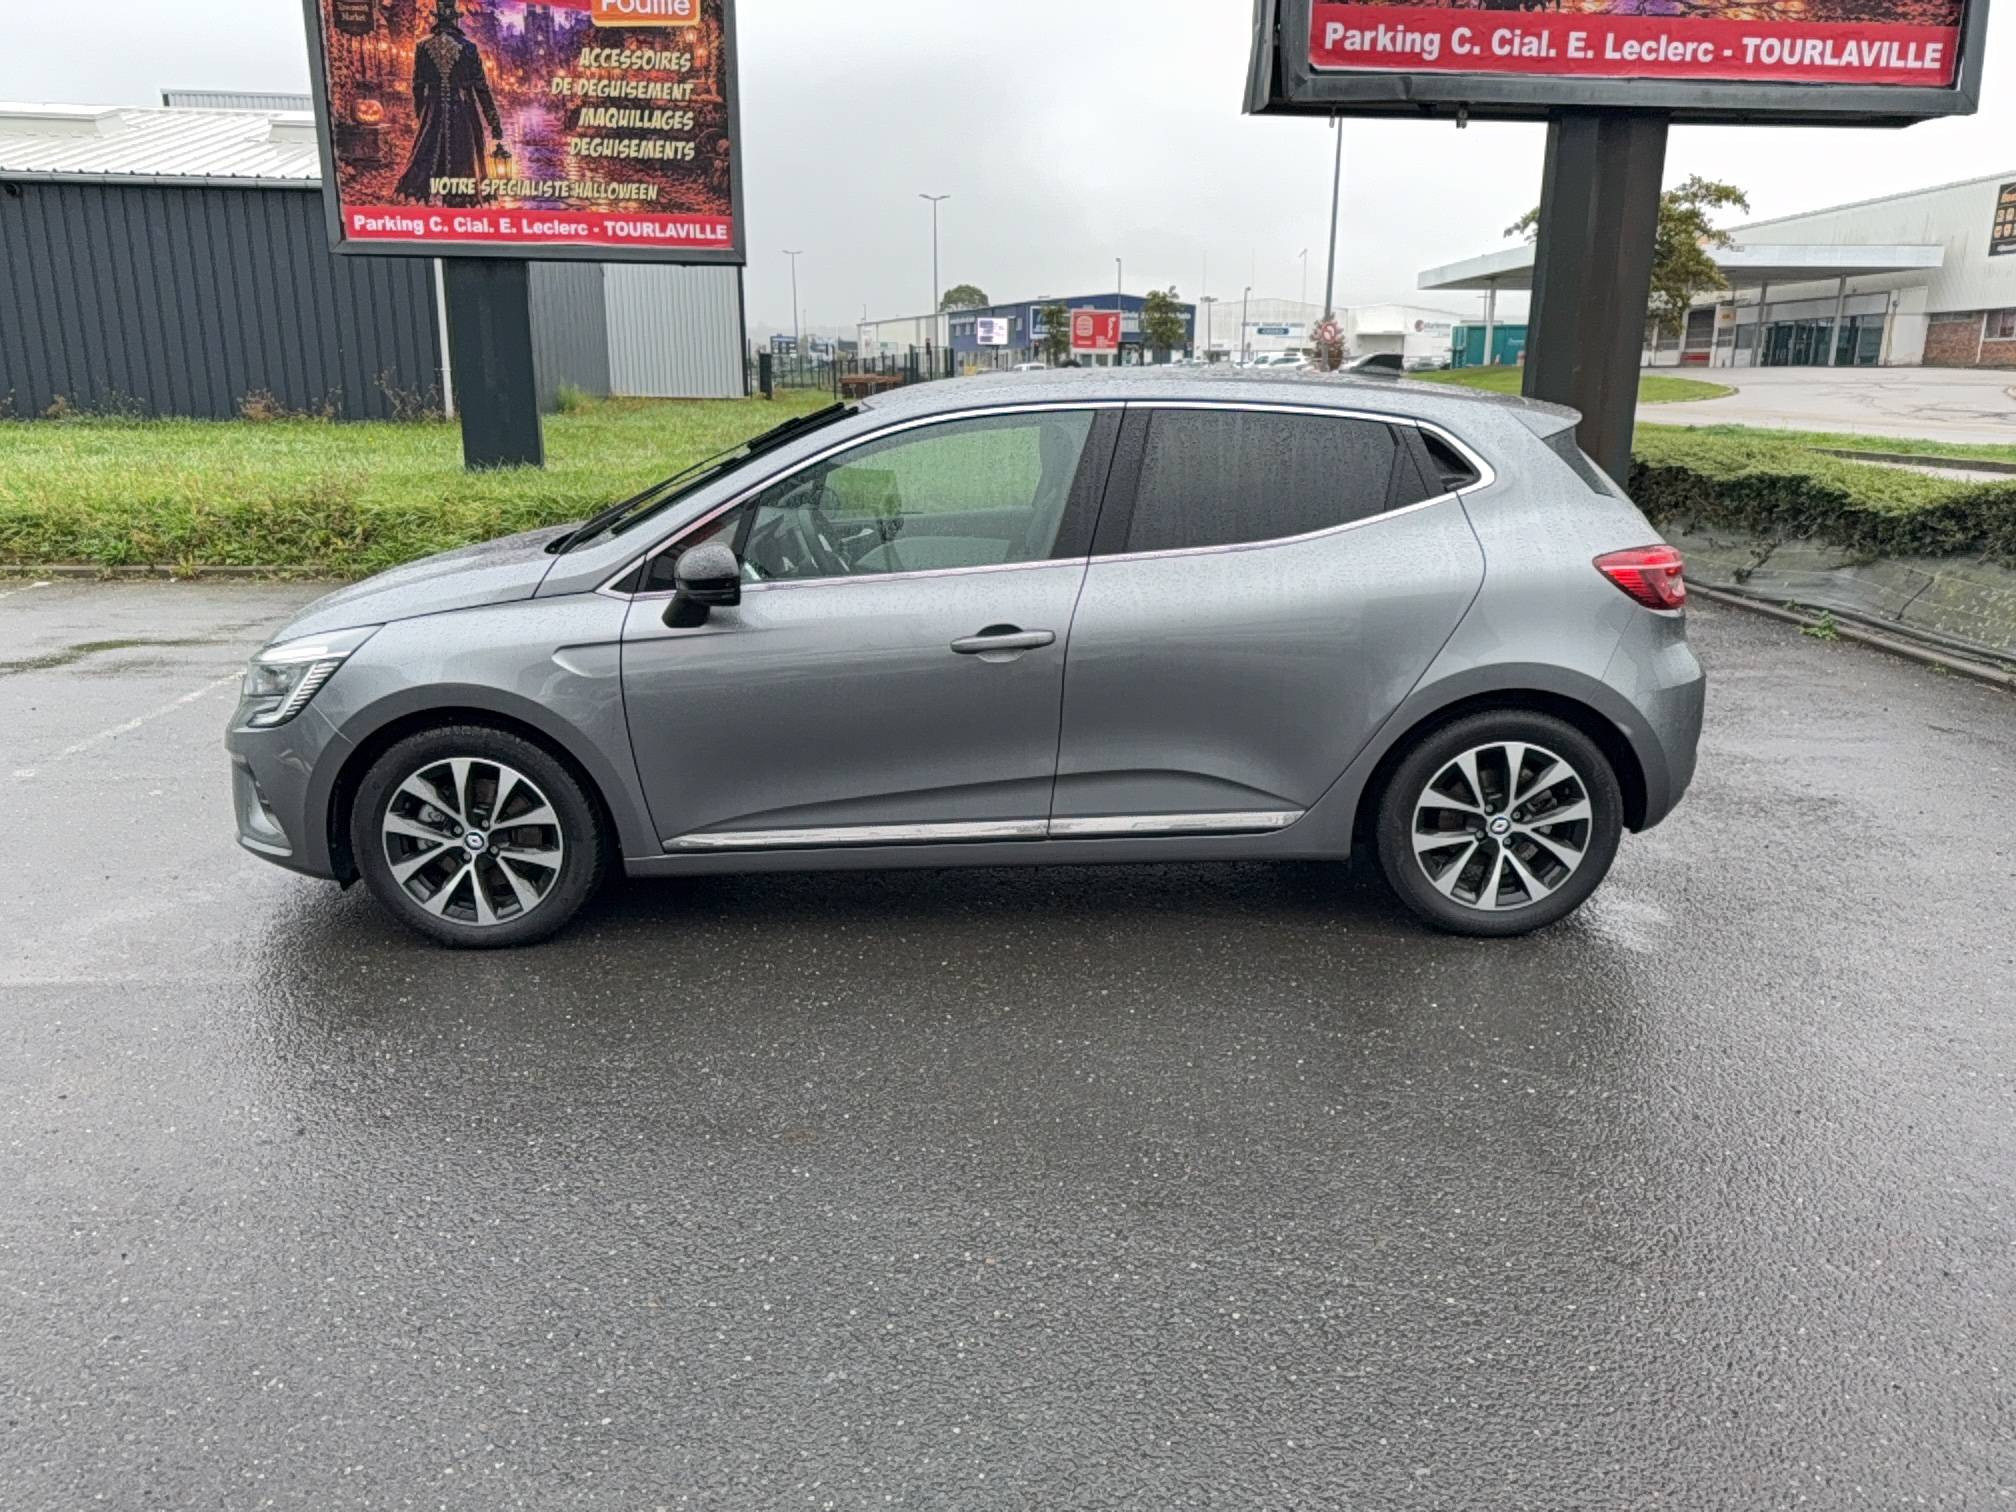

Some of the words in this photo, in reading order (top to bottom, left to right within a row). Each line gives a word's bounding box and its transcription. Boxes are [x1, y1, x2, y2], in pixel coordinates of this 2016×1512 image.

[1324, 21, 1441, 61] Parking
[1451, 27, 1481, 55] C.
[1491, 27, 1557, 58] Cial.
[1567, 31, 1594, 59] E.
[1604, 32, 1714, 63] Leclerc
[1742, 37, 1944, 69] TOURLAVILLE
[578, 47, 692, 73] ACCESSOIRES
[551, 77, 572, 96] DE
[577, 78, 694, 101] DEGUISEMENT
[577, 107, 695, 131] MAQUILLAGES
[569, 137, 696, 161] DEGUISEMENTS
[430, 176, 477, 195] VOTRE
[480, 177, 570, 198] SPECIALISTE
[574, 181, 659, 201] HALLOWEEN
[353, 214, 425, 235] Parking
[429, 216, 449, 232] C.
[453, 217, 494, 234] Cial.
[499, 218, 517, 234] E.
[522, 218, 589, 236] Leclerc
[603, 220, 728, 240] TOURLAVILLE
